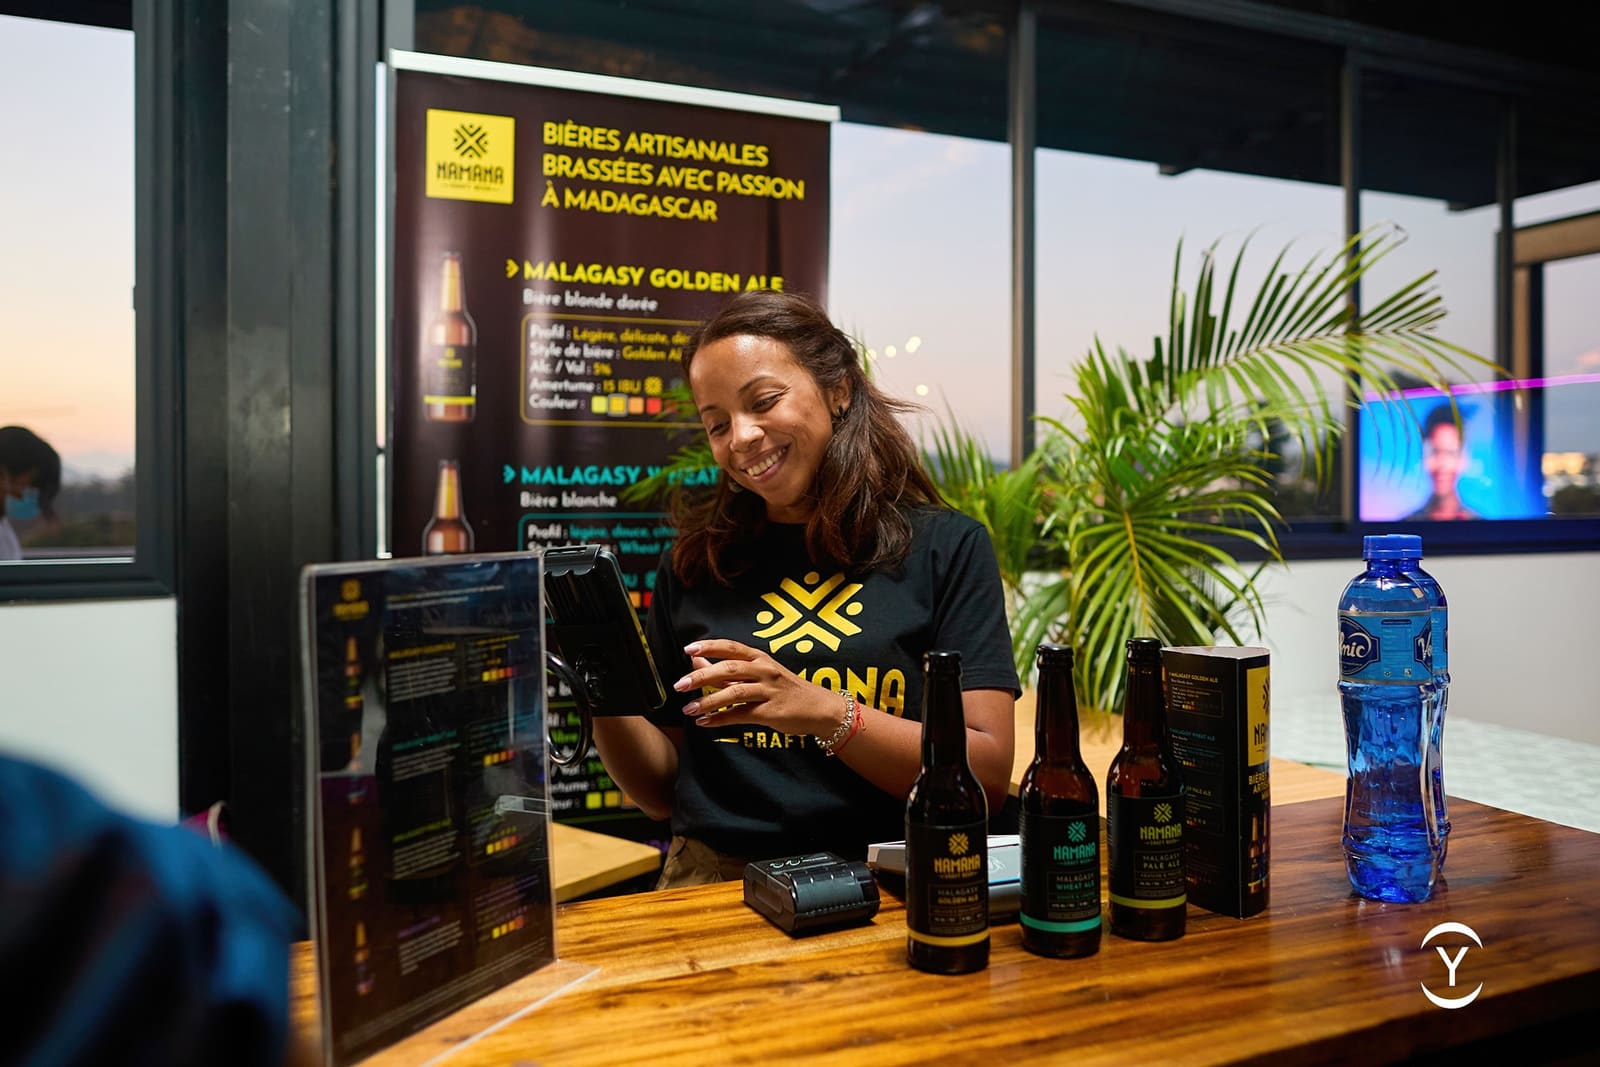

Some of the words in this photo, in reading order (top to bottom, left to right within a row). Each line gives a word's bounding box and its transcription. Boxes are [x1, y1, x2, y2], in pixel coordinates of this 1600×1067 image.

[543, 119, 620, 151] BIÈRES
[625, 132, 769, 168] ARTISANALES
[437, 161, 504, 184] NAMANA
[543, 153, 653, 186] BRASSÉES
[656, 165, 713, 193] AVEC
[717, 172, 805, 200] PASSION
[541, 181, 560, 208] À
[564, 188, 718, 222] MADAGASCAR
[523, 261, 645, 286] MALAGASY
[649, 268, 740, 293] GOLDEN
[744, 275, 784, 293] ALE
[522, 288, 562, 306] Bière
[564, 290, 613, 310] blonde
[616, 293, 658, 312] dorée
[529, 324, 565, 340] Profil
[529, 343, 562, 359] Style
[563, 344, 581, 358] de
[582, 345, 614, 360] bière
[622, 347, 666, 361] Golden
[668, 347, 683, 361] Al
[529, 359, 552, 375] Alc
[565, 361, 586, 376] Vol
[529, 378, 595, 393] Amertume
[602, 378, 616, 393] 15
[617, 379, 641, 394] IBU
[529, 395, 579, 409] Couleur
[520, 466, 641, 486] MALAGASY
[519, 492, 558, 508] Bière
[561, 491, 618, 508] blanche
[527, 524, 562, 540] Profil
[743, 732, 807, 748] CRAFT
[1140, 823, 1183, 841] NAMANA
[1053, 842, 1096, 861] NAMANA
[934, 854, 981, 874] NAMANA
[1143, 862, 1164, 870] PALE
[1167, 859, 1181, 868] ALE
[1056, 872, 1095, 883] MALAGASY
[1056, 882, 1082, 891] WHEAT
[1084, 880, 1096, 888] ALE
